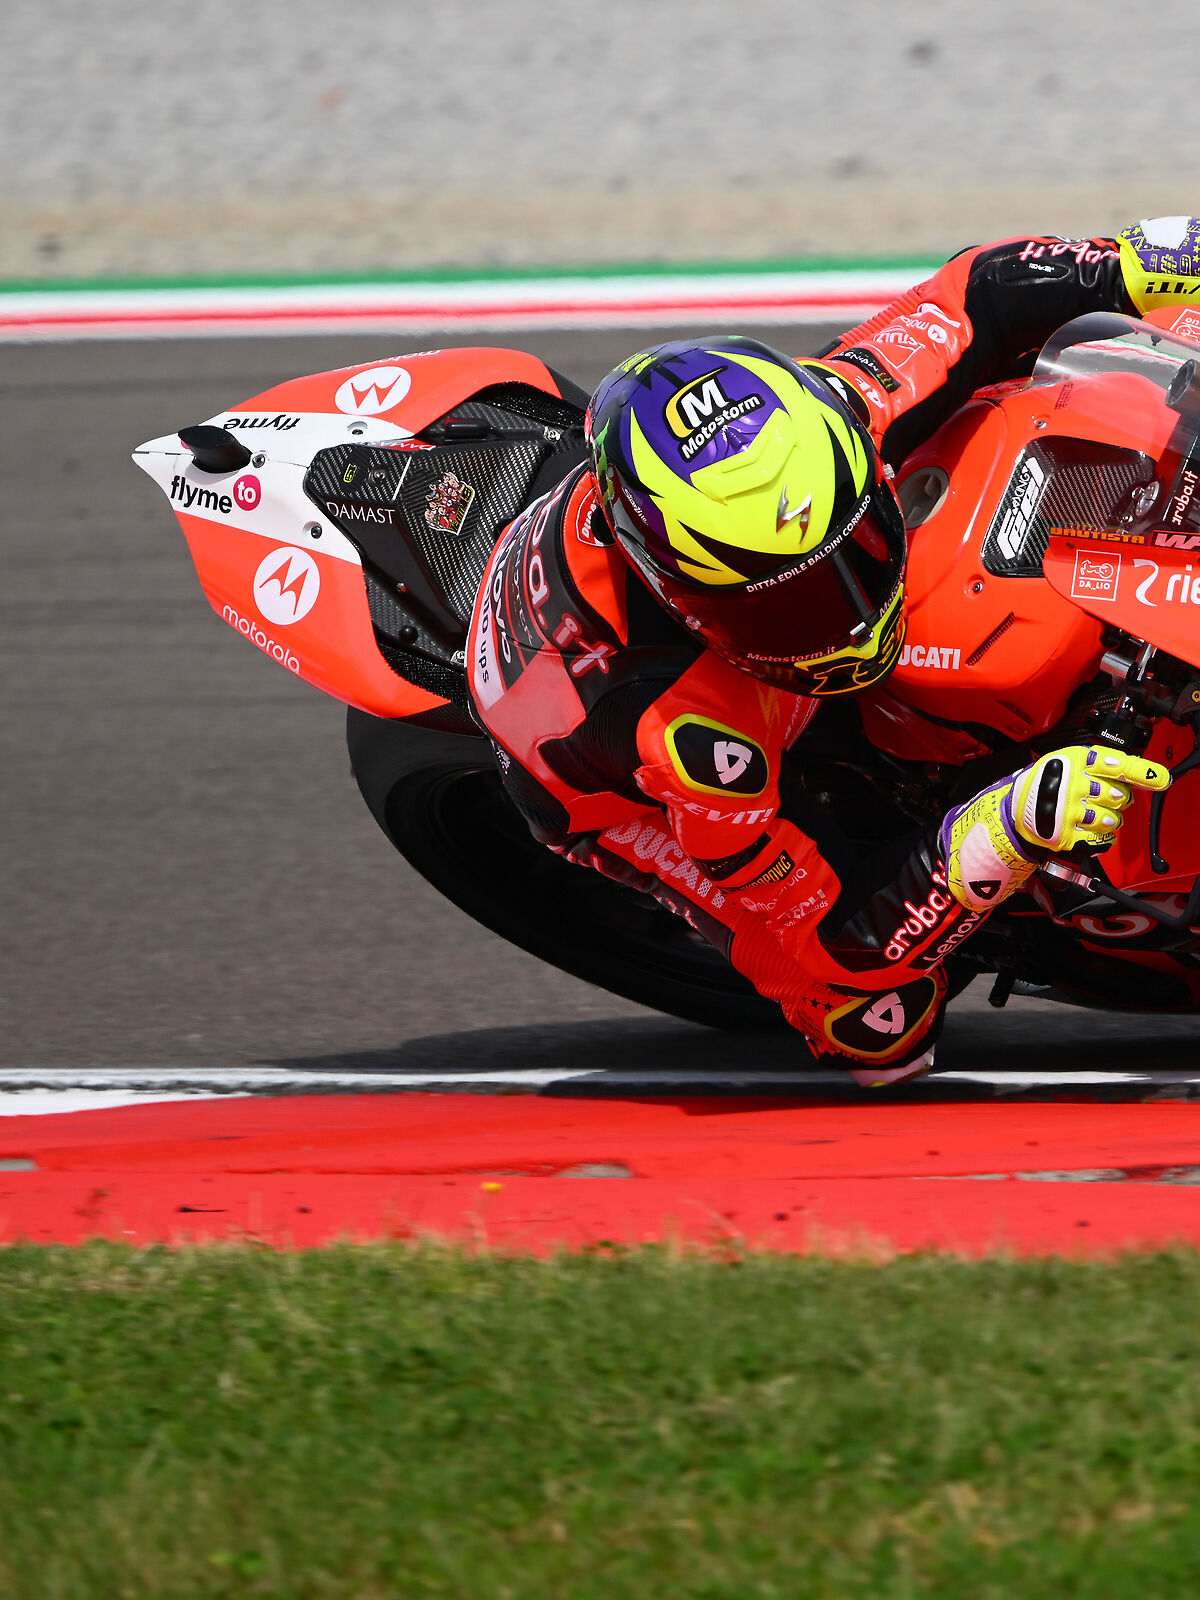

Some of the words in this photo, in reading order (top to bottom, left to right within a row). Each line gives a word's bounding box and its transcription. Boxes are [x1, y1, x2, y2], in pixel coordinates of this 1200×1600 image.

[222, 414, 301, 431] flyme
[680, 394, 762, 460] Motostorm
[170, 475, 233, 514] flyme
[235, 482, 257, 503] to
[326, 502, 396, 525] DAMAST
[745, 577, 778, 593] DITTA
[777, 564, 808, 584] EDILE
[807, 535, 845, 566] BALDINI
[842, 494, 872, 538] CORRADO
[1050, 527, 1146, 545] BAUTISTA
[1078, 580, 1112, 592] DA_LIO
[221, 604, 301, 674] motorola
[898, 644, 962, 670] UCATI
[478, 640, 489, 684] ups
[1100, 728, 1126, 745] domino
[884, 859, 953, 961] aruba.i
[923, 912, 981, 963] Lenov
